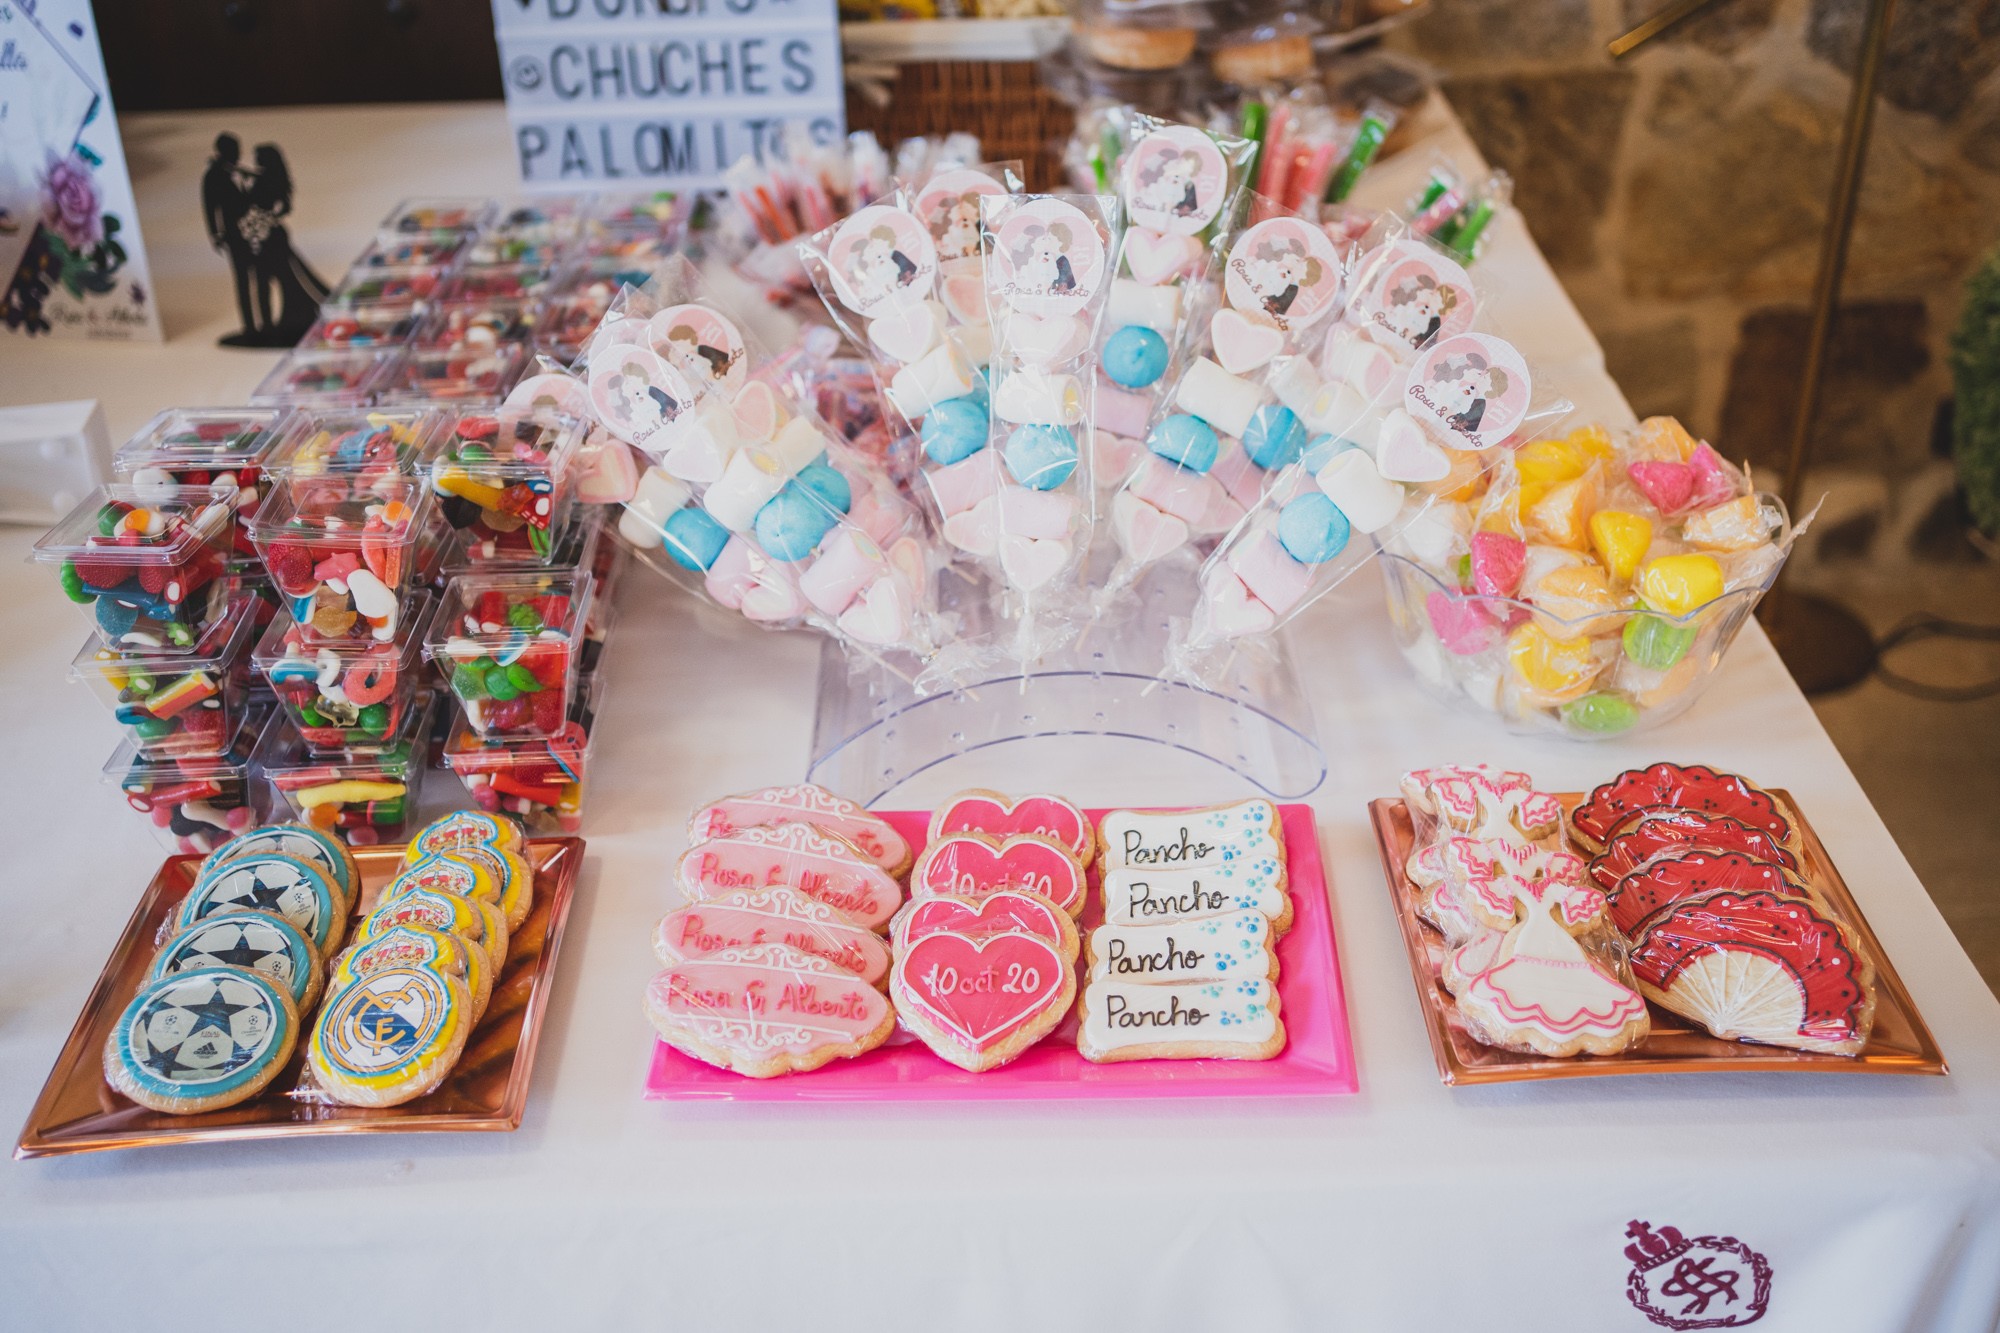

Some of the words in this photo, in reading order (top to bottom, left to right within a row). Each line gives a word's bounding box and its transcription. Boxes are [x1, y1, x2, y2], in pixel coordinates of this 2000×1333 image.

[550, 40, 816, 99] CHUCHES
[1408, 384, 1436, 411] Rosa
[1435, 405, 1449, 418] &
[1123, 827, 1215, 866] Pancho
[1129, 880, 1229, 918] Pancho
[1108, 937, 1205, 975] Pancho
[667, 974, 732, 1007] Rosa
[775, 983, 868, 1021] Alberto
[920, 963, 958, 997] 10
[959, 965, 1000, 995] oct
[1002, 963, 1041, 994] 20
[1106, 995, 1210, 1029] Pancho
